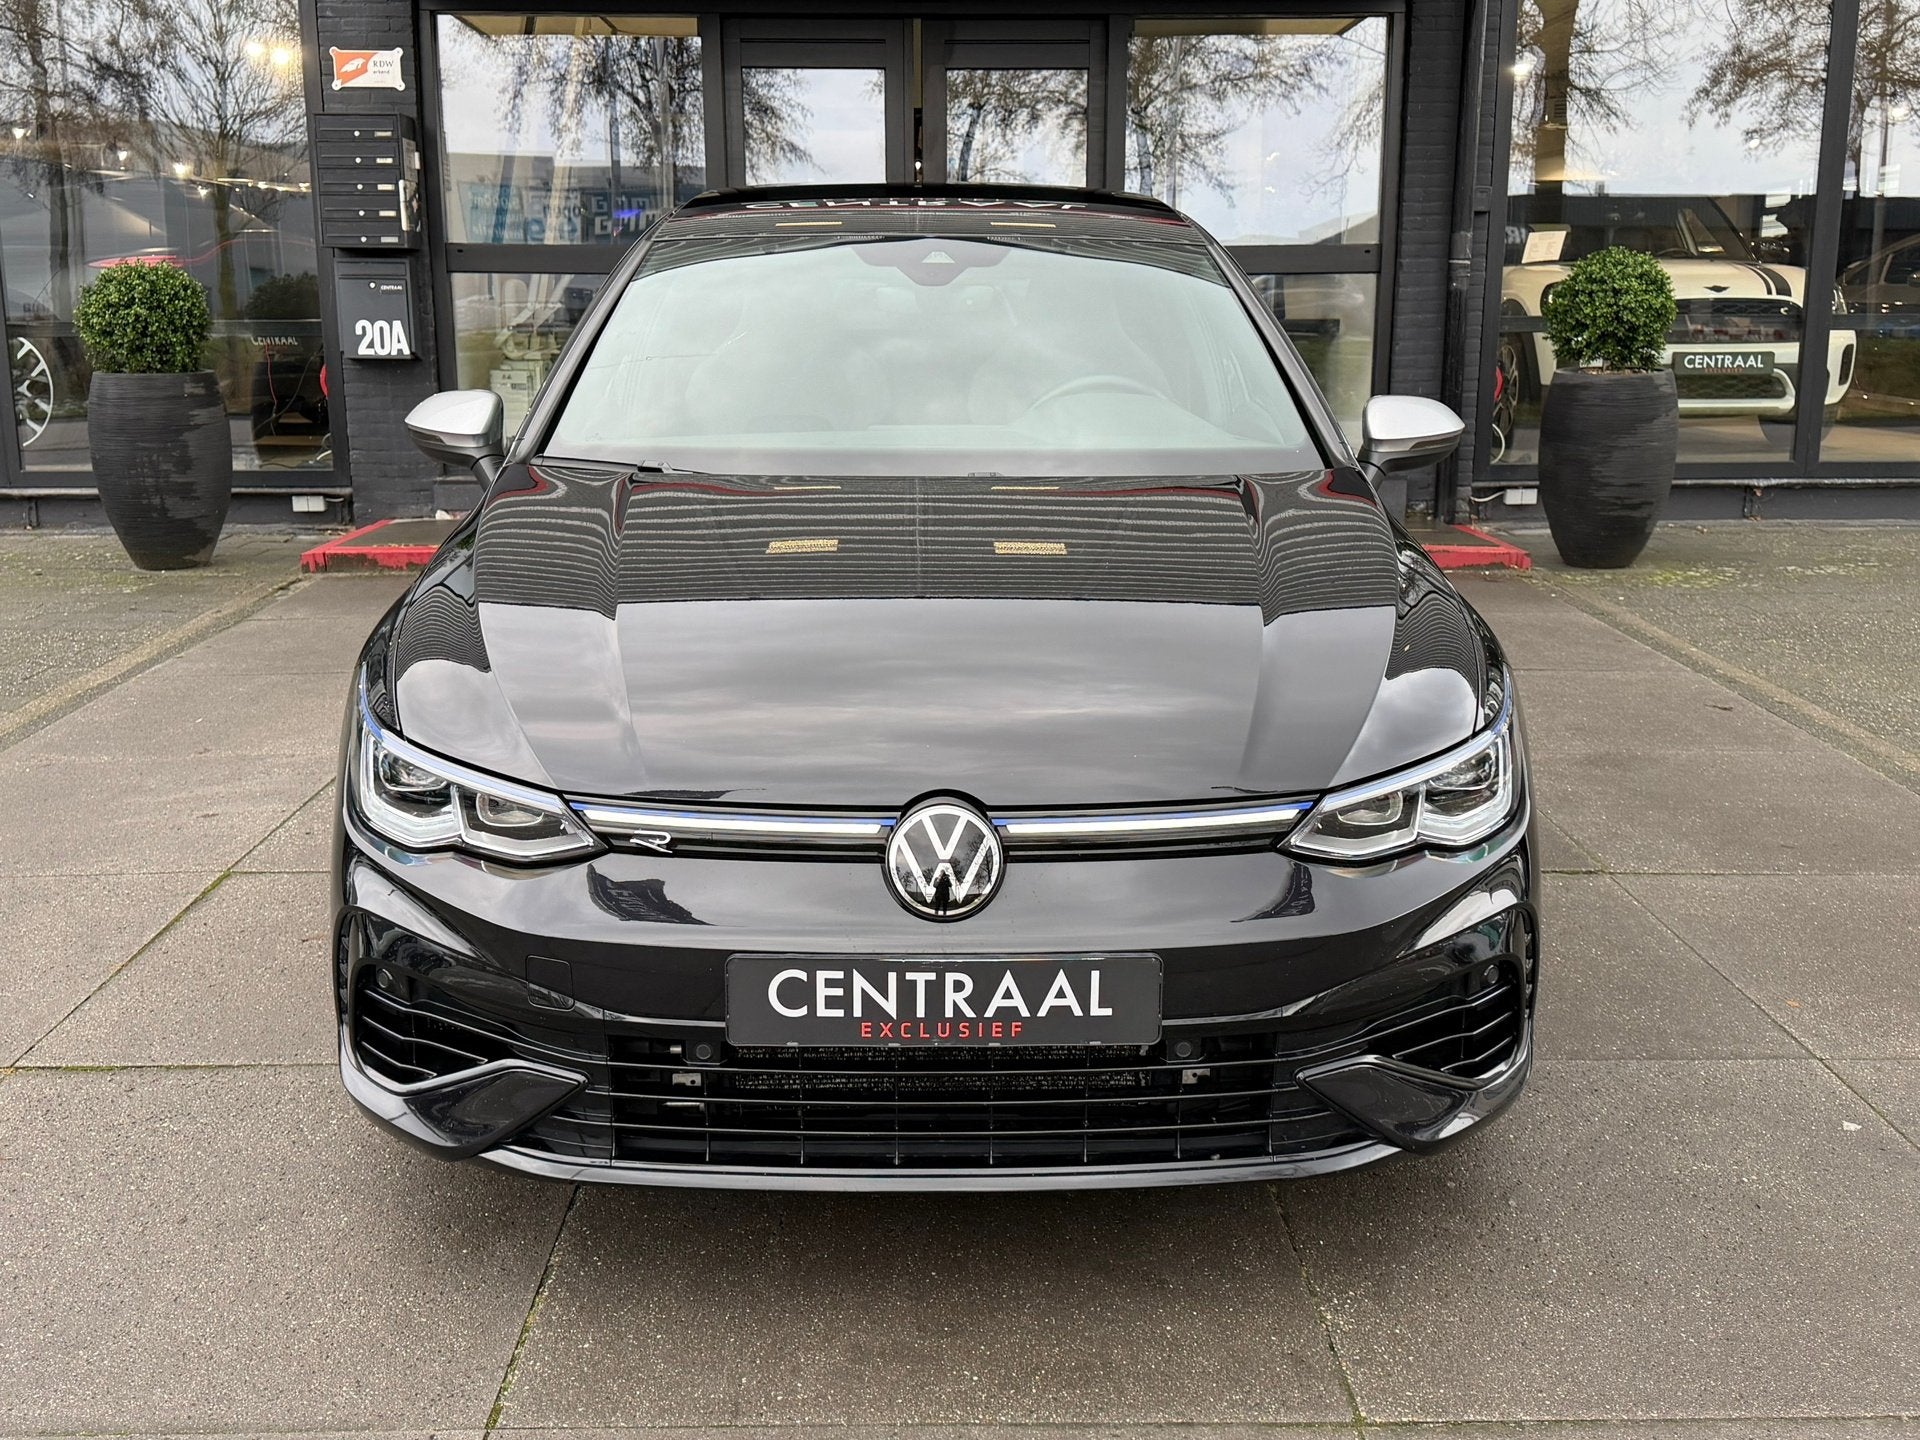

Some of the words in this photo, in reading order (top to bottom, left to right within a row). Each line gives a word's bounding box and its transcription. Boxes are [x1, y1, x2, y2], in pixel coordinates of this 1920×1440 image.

[372, 60, 395, 68] RDW
[354, 319, 411, 356] 20A
[1684, 354, 1764, 368] CENTRAAL
[767, 969, 1112, 1020] CENTRAAL
[860, 1022, 1023, 1038] EXCLUSIEF
